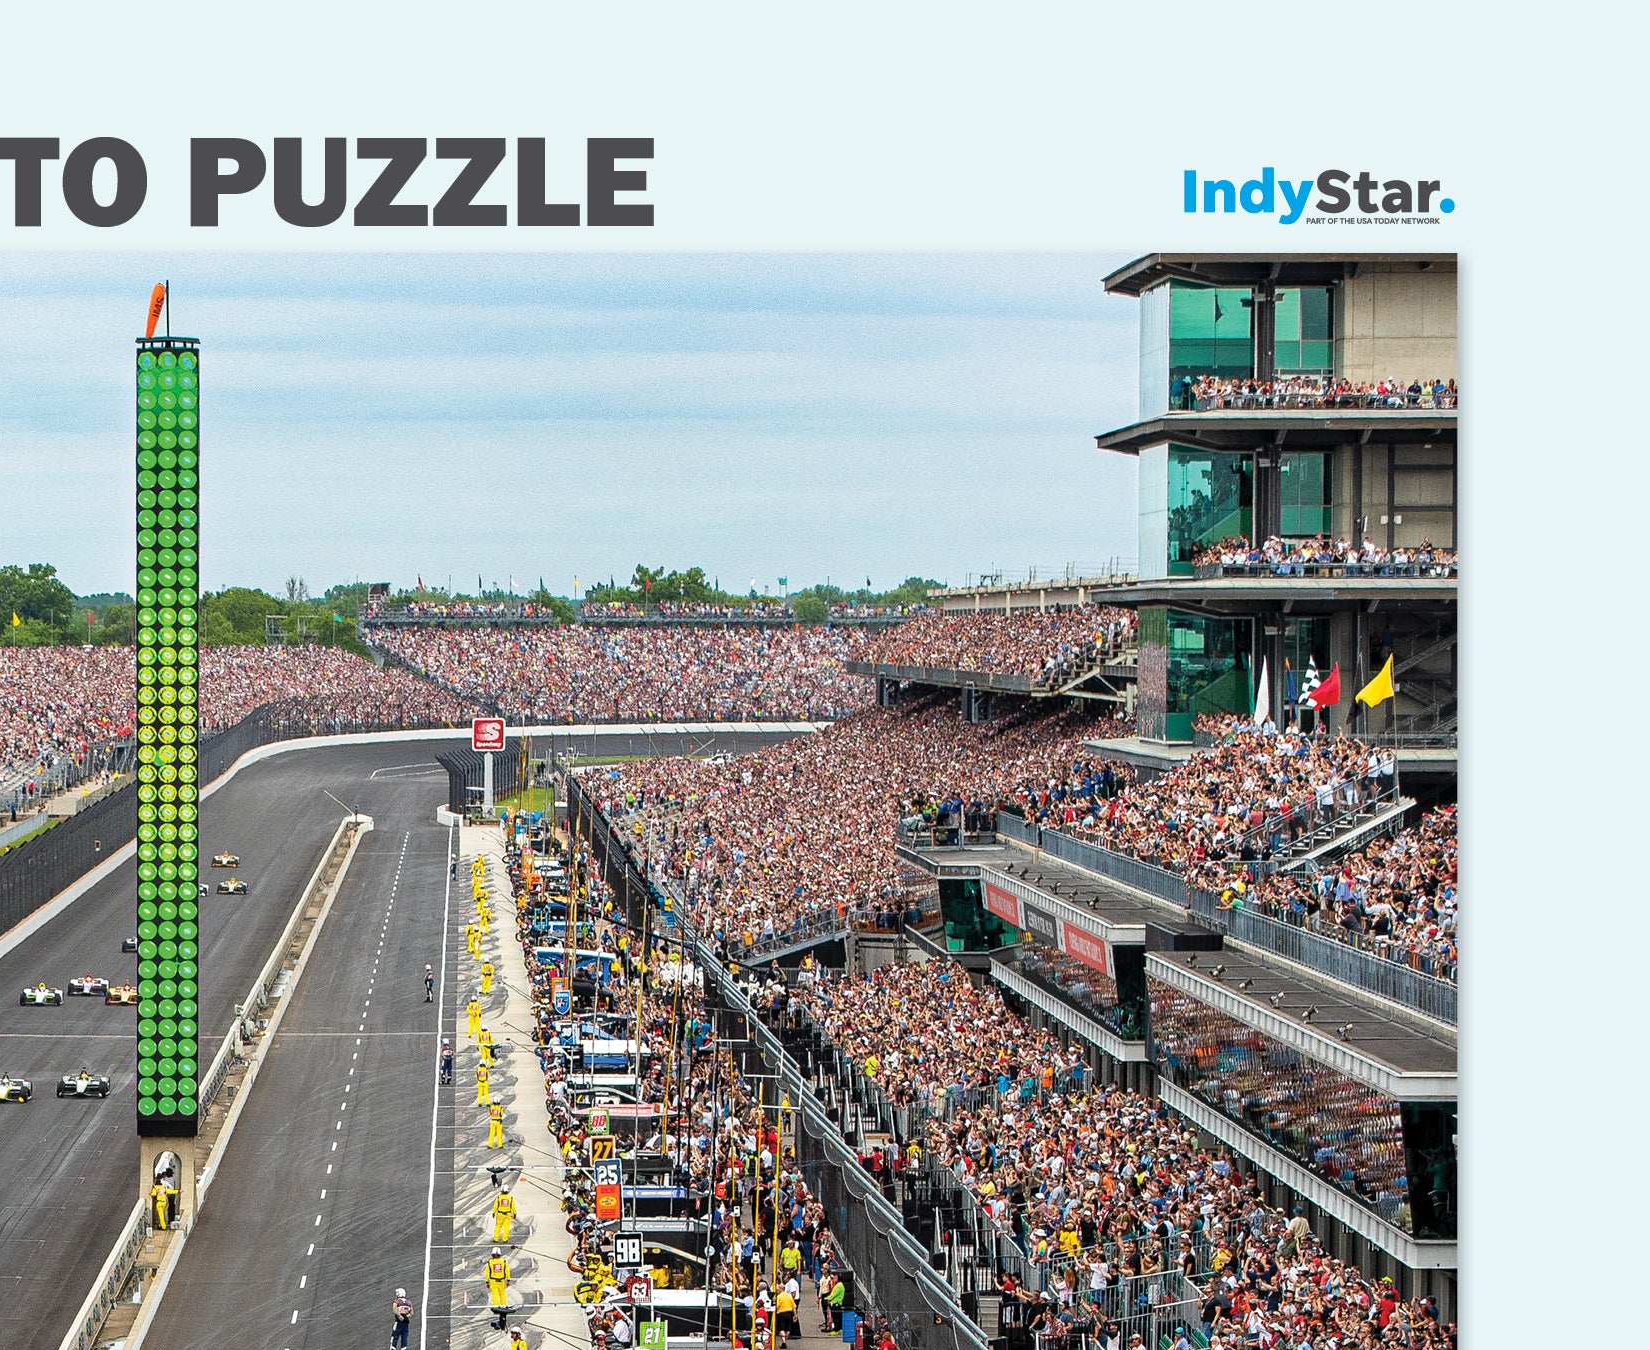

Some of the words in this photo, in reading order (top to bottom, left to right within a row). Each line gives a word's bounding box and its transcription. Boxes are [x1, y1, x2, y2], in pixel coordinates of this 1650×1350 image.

[592, 1141, 613, 1160] 27
[597, 1165, 619, 1185] 25
[616, 1239, 641, 1263] 98
[631, 1283, 649, 1298] 63
[644, 1328, 660, 1344] 21
